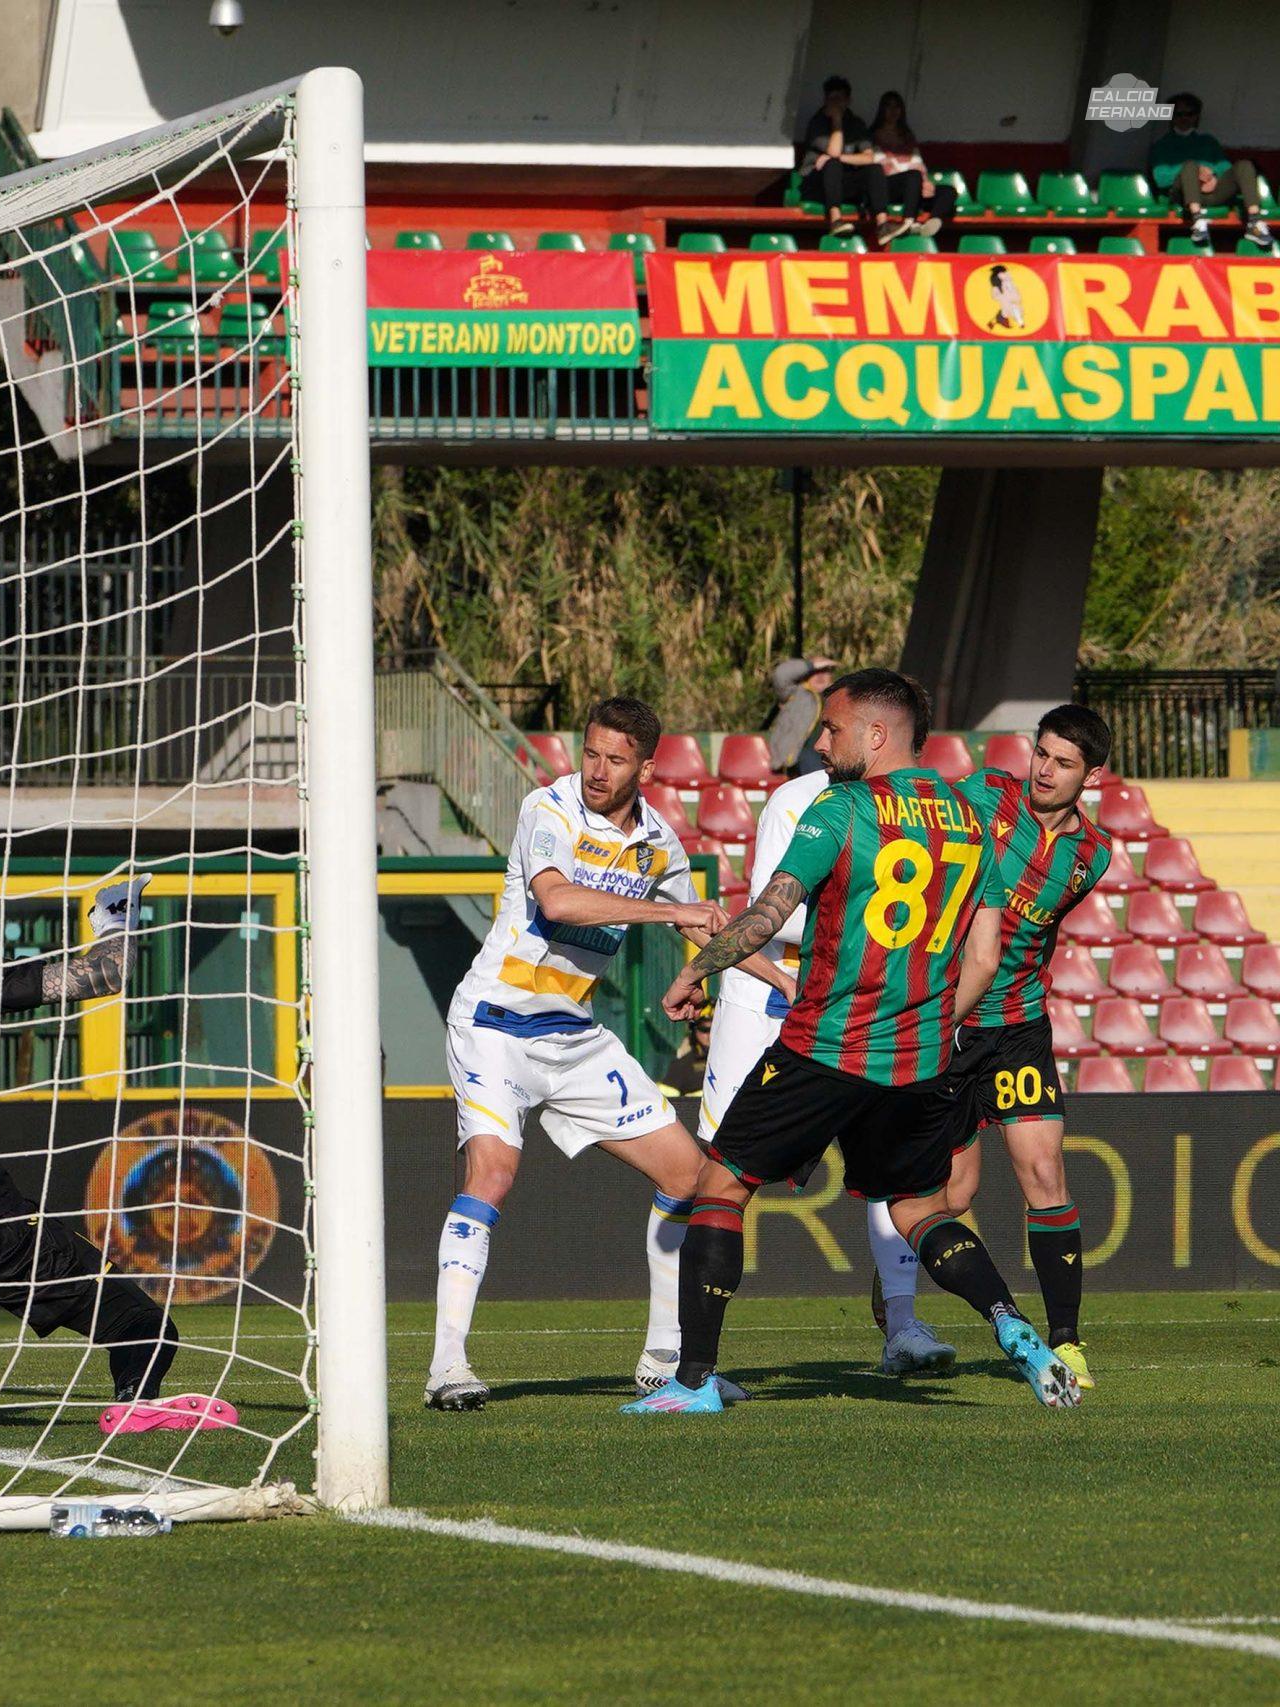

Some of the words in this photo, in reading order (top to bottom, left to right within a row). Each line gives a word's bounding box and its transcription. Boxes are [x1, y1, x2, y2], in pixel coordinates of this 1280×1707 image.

[371, 322, 500, 354] VETERANI
[506, 322, 636, 355] MONTORO
[686, 344, 1280, 427] ACQUASPA
[873, 794, 983, 835] MARTELLA
[863, 838, 984, 954] 87
[606, 1069, 628, 1108] 7
[995, 1065, 1042, 1110] 80
[742, 1133, 1280, 1274] RDI
[702, 1284, 734, 1299] 192
